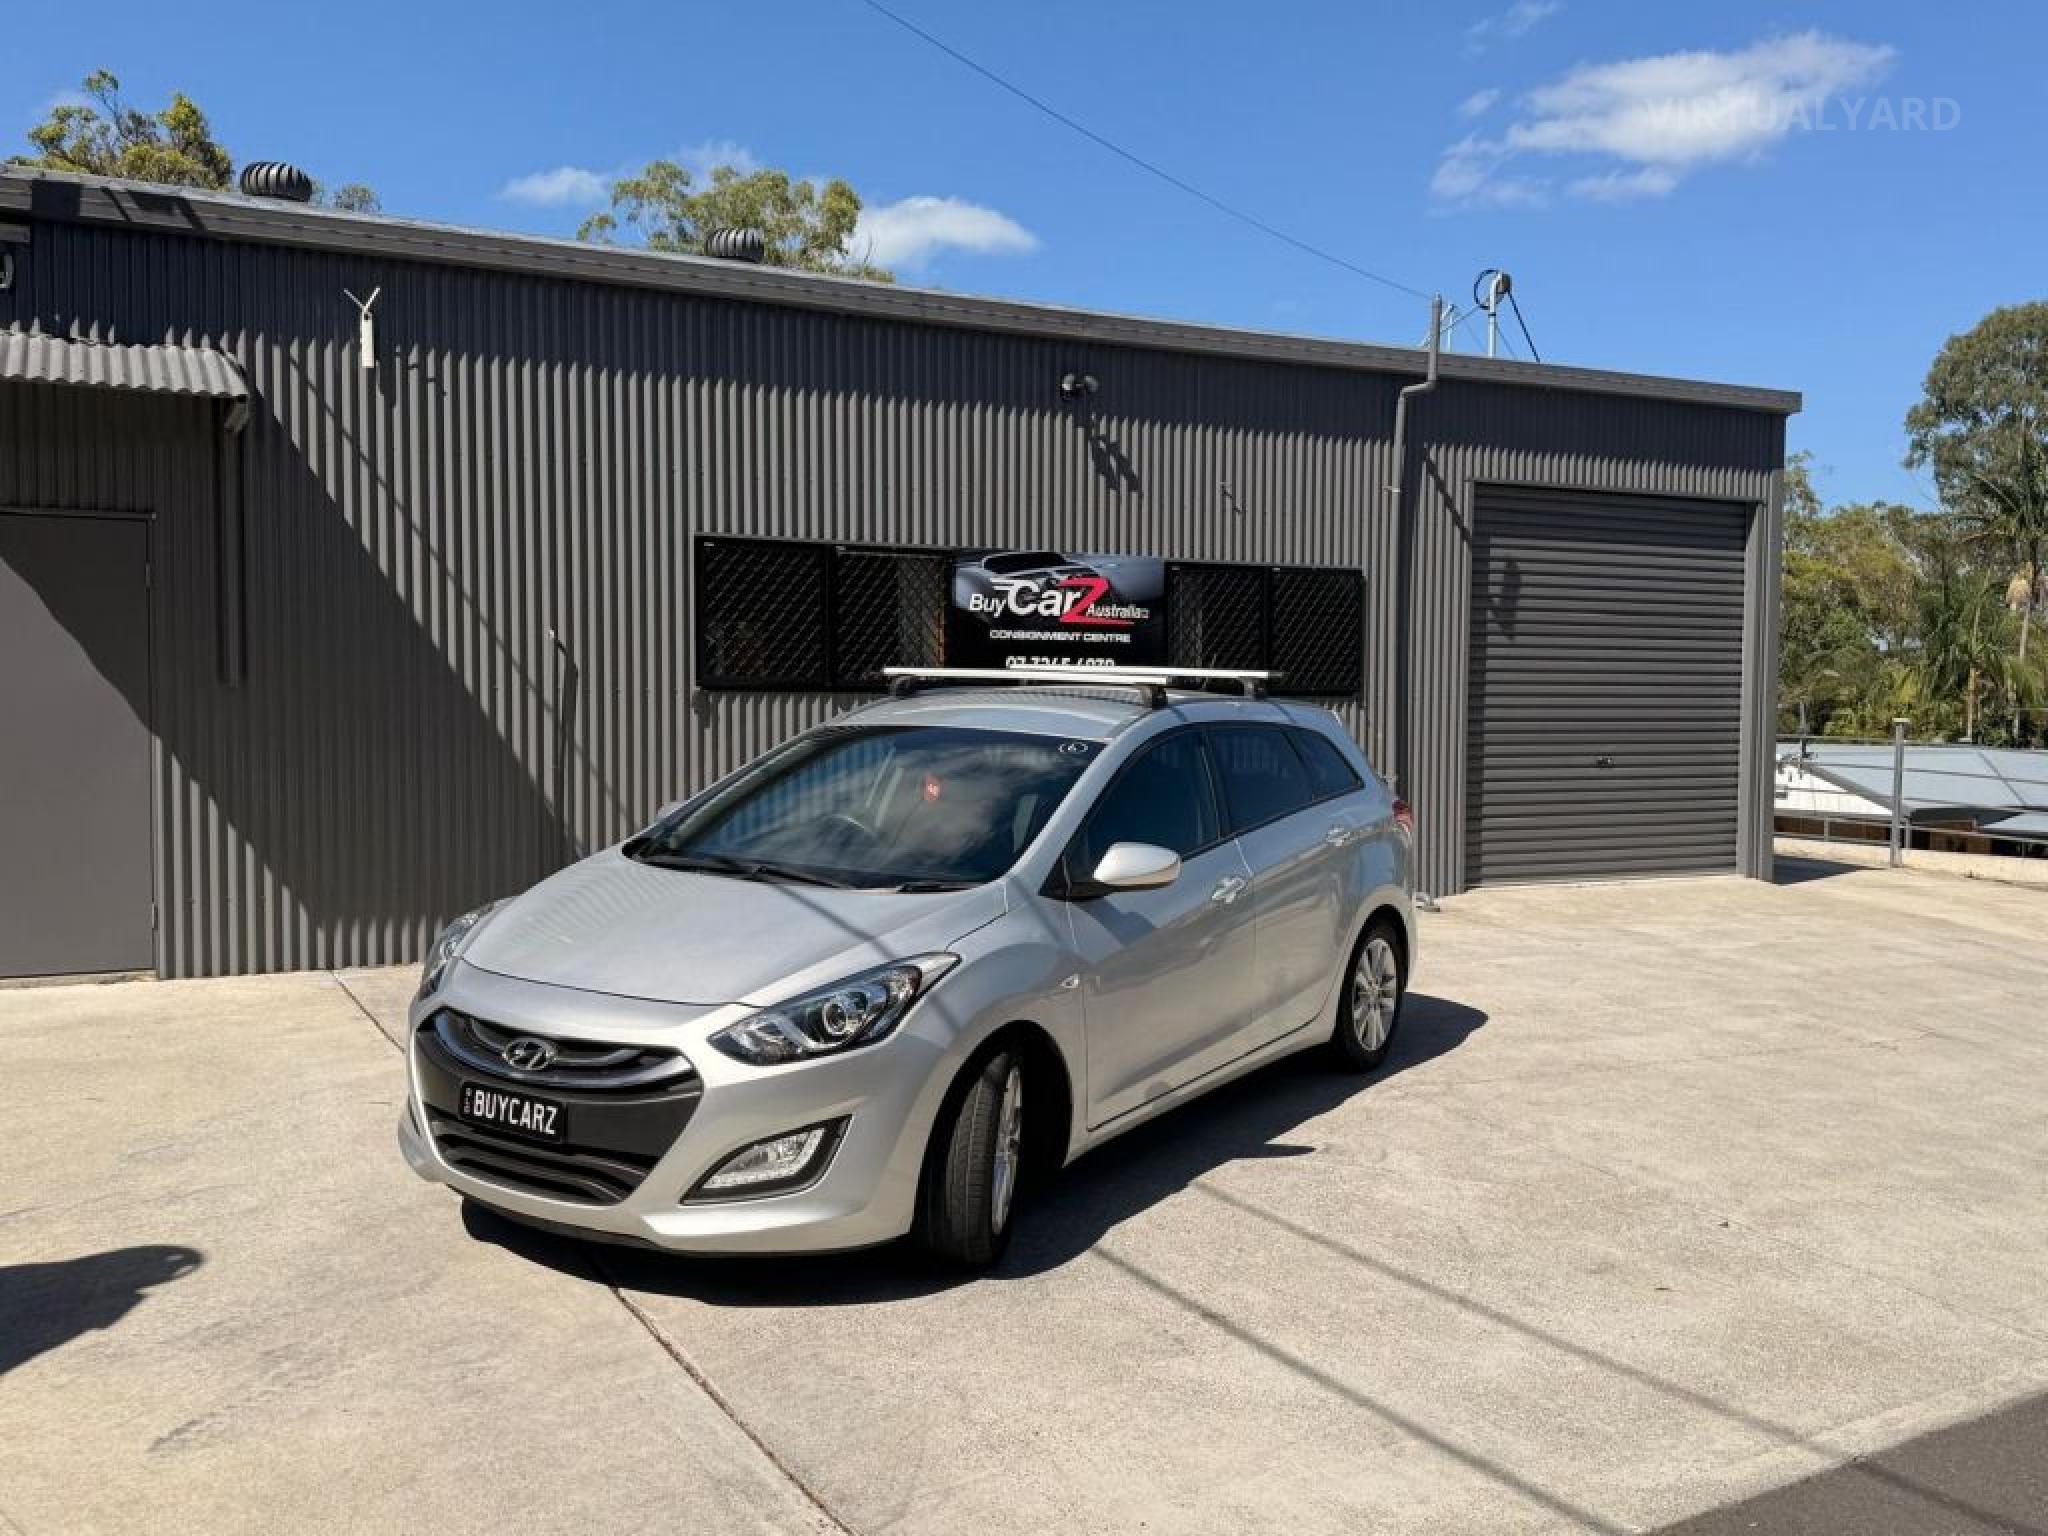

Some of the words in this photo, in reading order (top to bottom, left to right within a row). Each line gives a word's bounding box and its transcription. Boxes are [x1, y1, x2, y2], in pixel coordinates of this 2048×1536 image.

[968, 594, 1007, 618] Buy
[1086, 603, 1144, 619] Australia
[1084, 632, 1131, 643] CENTRE
[473, 1089, 558, 1135] BUYCARZ
